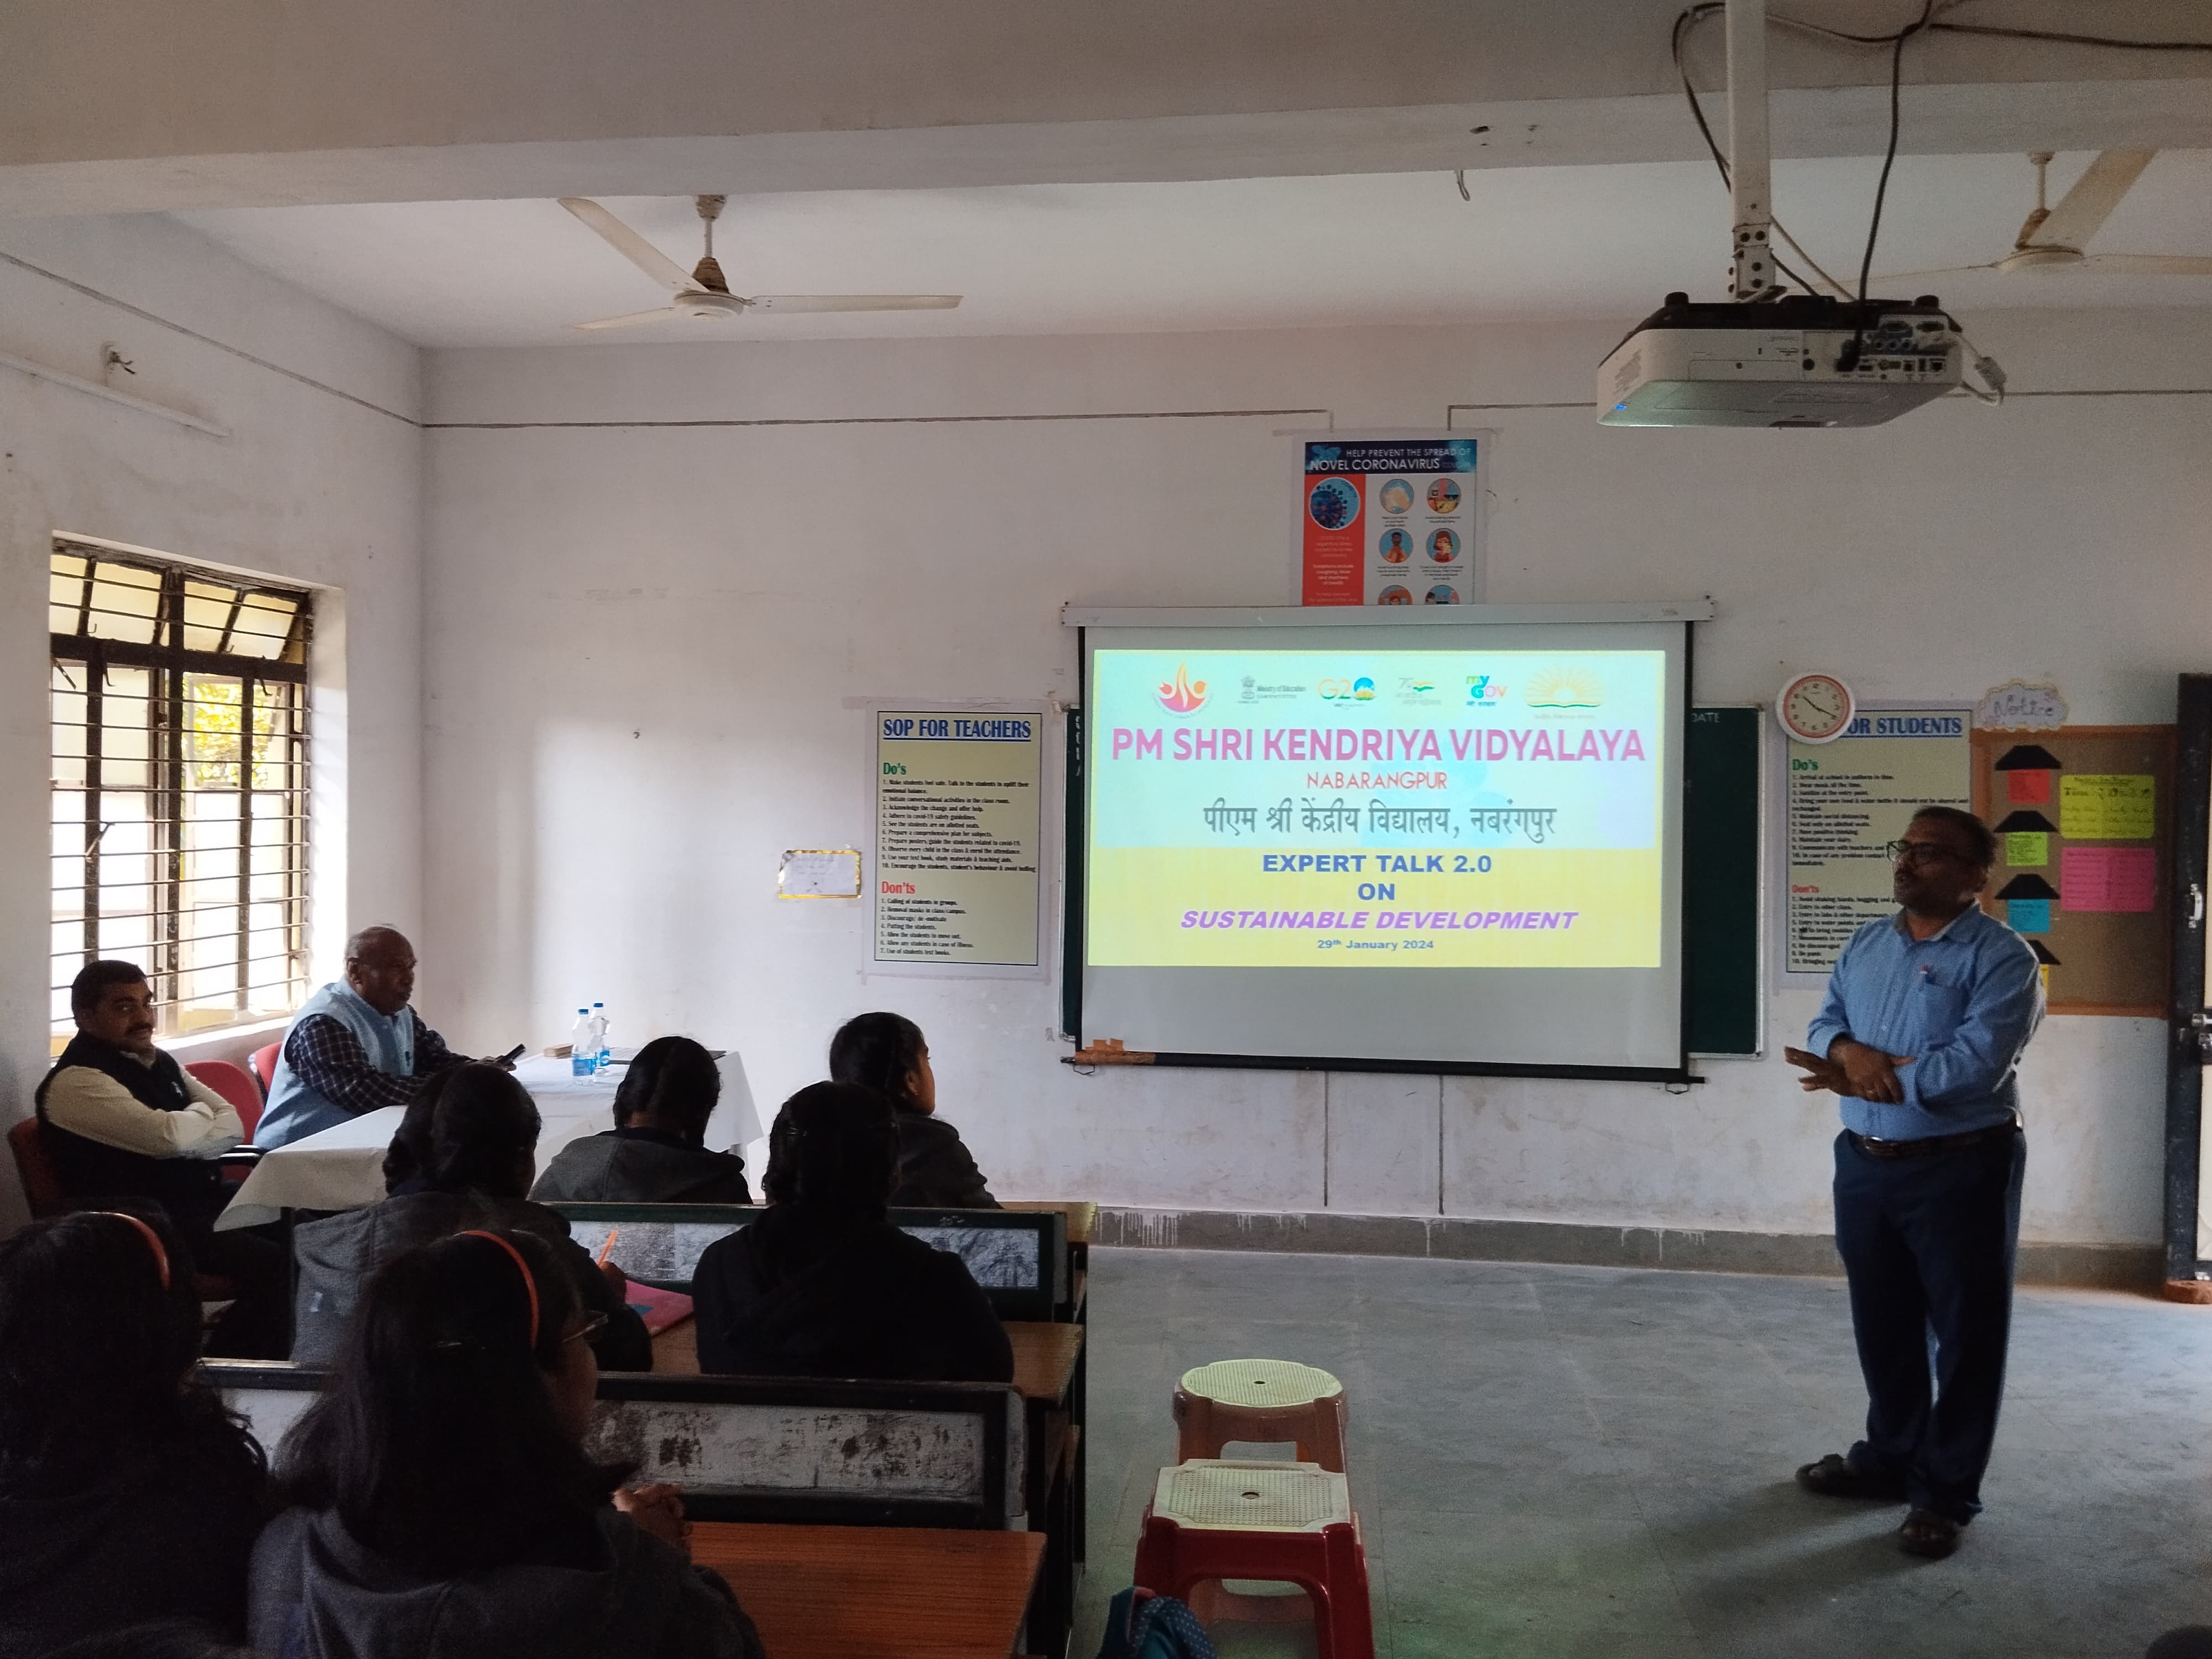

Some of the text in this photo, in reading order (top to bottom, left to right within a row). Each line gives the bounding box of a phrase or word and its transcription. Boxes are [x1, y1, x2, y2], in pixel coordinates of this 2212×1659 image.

[1368, 449, 1405, 457] PREVENT
[1424, 448, 1455, 456] SPREAD
[1311, 460, 1350, 471] NOVEL
[1352, 458, 1441, 470] CORONAVIRUS
[883, 719, 1031, 738] SOP FOR TEACHERS
[1848, 717, 1962, 734] OR STUDENTS
[1112, 728, 1164, 760] PM
[1173, 728, 1253, 761] SHRI
[1264, 728, 1443, 761] KENDRIYA
[1449, 729, 1646, 761] VIDYALAYA
[883, 762, 906, 775] Do's
[1792, 759, 1819, 770] Do's
[1307, 771, 1448, 789] NABARANGPUR
[1203, 797, 1557, 844] पीएम श्री केंद्रीय विद्यालय, नबरंगपुर
[1262, 854, 1493, 873] EXPERT TALK 2.0
[882, 881, 916, 894] Don'ts
[1358, 883, 1396, 901] ON
[1181, 910, 1579, 930] SUSTAINABLE DEVELOPMENT
[1317, 939, 1434, 952] 29th January 2024
